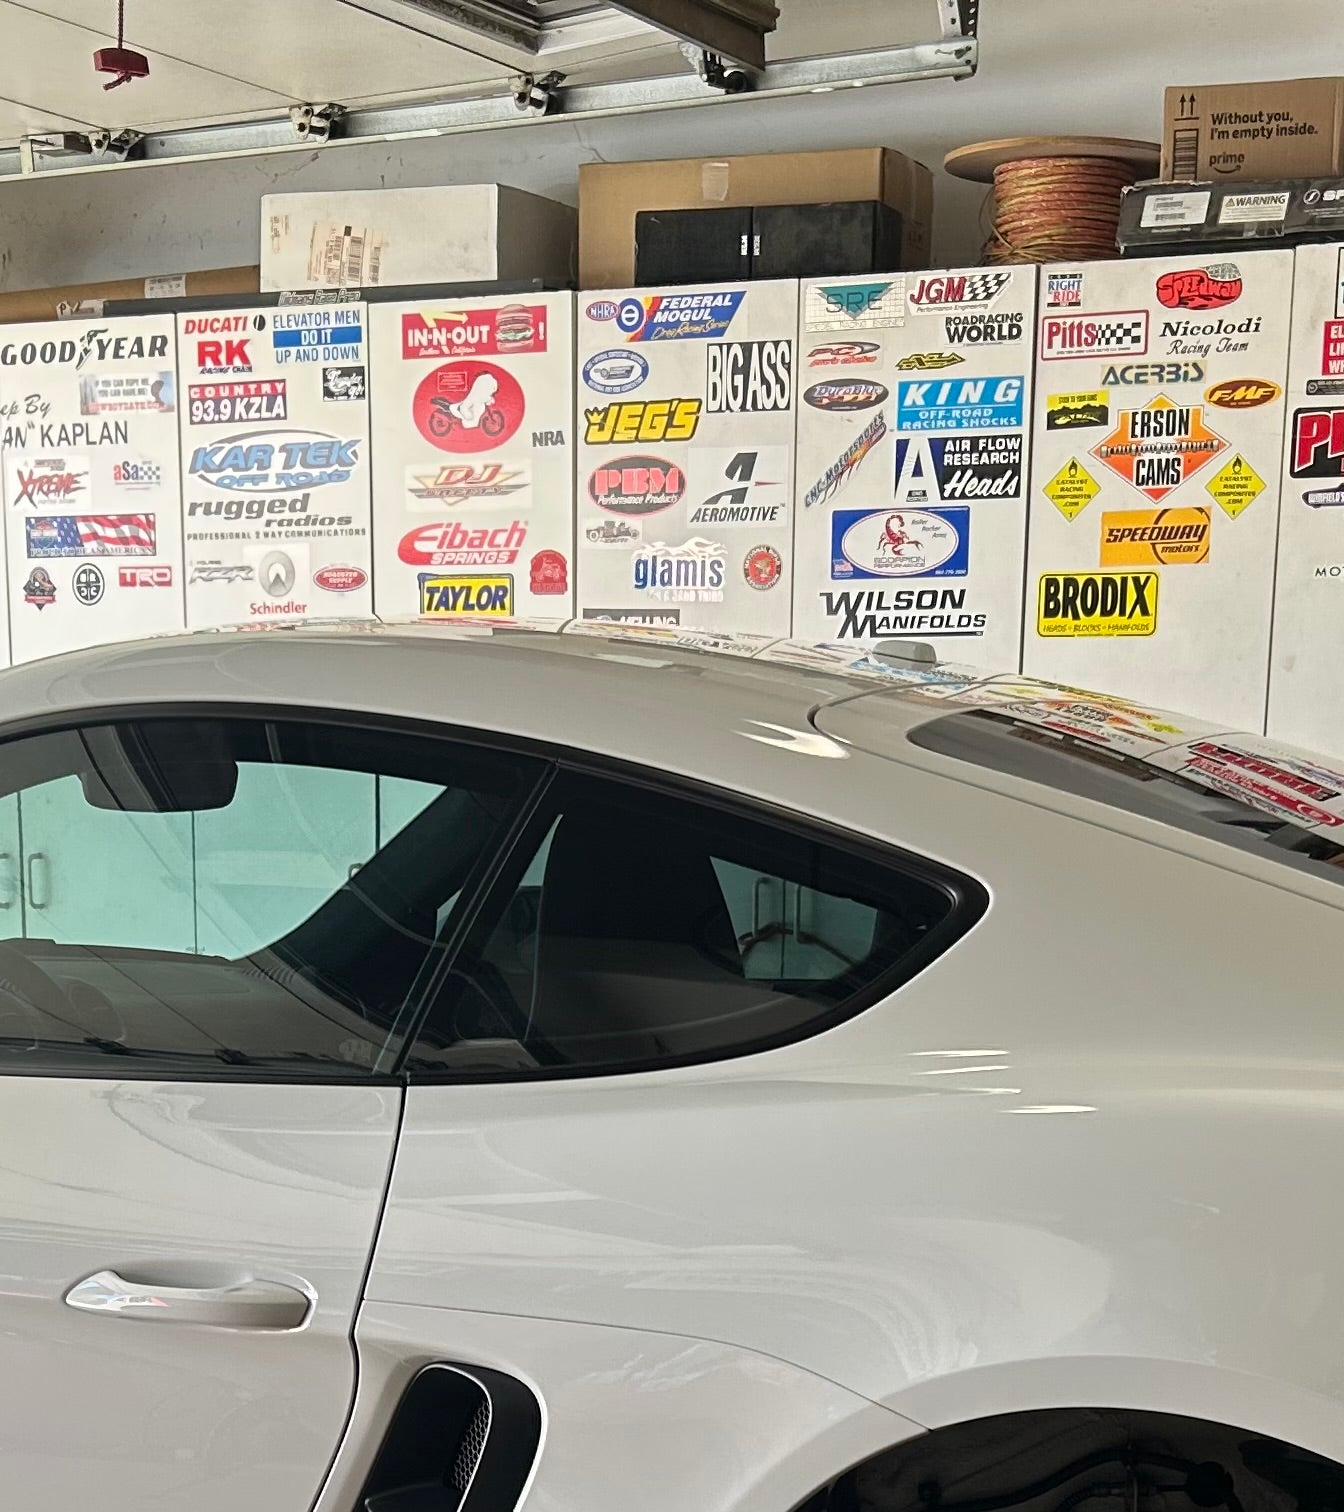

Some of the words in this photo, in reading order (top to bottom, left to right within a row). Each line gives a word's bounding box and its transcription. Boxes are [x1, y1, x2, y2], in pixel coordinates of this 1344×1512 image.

[1210, 112, 1263, 125] Without
[1265, 112, 1294, 124] you,
[1210, 127, 1229, 140] I'm
[1232, 125, 1274, 140] empty
[1276, 122, 1318, 136] inside.
[1209, 153, 1245, 167] prime
[1236, 195, 1286, 207] WARNING
[910, 276, 967, 304] JGM
[1048, 280, 1082, 291] RIGHT
[660, 294, 733, 309] FEDERAL
[1053, 290, 1081, 302] RIDE
[273, 313, 331, 329] ELEVATOR
[335, 310, 360, 324] MEN
[590, 304, 617, 318] NHRA
[654, 308, 712, 323] MOGUL
[945, 313, 1024, 326] ROADRACING
[184, 316, 248, 335] DUCATI
[946, 323, 1022, 343] WORLD
[1047, 321, 1096, 349] Pitts
[1159, 317, 1262, 337] Nicolodi
[301, 330, 318, 345] DO
[321, 329, 333, 344] IT
[197, 339, 251, 367] RK
[276, 349, 291, 364] UP
[295, 347, 319, 362] AND
[323, 345, 359, 360] DOWN
[1167, 340, 1211, 358] Racing
[1215, 337, 1249, 353] Team
[709, 342, 743, 412] BIG
[746, 341, 790, 411] ASS
[190, 382, 285, 398] COUNTRY
[904, 379, 1022, 406] KING
[1208, 386, 1276, 401] FMF
[24, 394, 50, 418] By
[191, 400, 232, 422] 93.9
[234, 396, 285, 420] KZLA
[919, 409, 993, 420] OFF-ROAD
[585, 399, 702, 444] JEG'S
[902, 420, 957, 430] RACING
[961, 417, 1018, 427] SHOCKS
[1130, 408, 1190, 439] ERSON
[40, 420, 128, 448] KAPLAN
[532, 430, 565, 447] NRA
[944, 440, 971, 451] AIR
[978, 438, 1020, 450] FLOW
[944, 452, 1020, 466] RESEARCH
[216, 474, 269, 488] OFF
[276, 469, 352, 486] ROAD
[434, 464, 503, 486] DJ
[595, 468, 679, 495] PBM
[1135, 458, 1181, 486] CAMS
[14, 468, 89, 509] XTREME
[944, 470, 1019, 498] Heads
[188, 493, 310, 520] rugged
[598, 494, 643, 505] Performance
[645, 494, 679, 504] Products
[265, 514, 352, 527] radios
[690, 506, 779, 523] AEROMOTIVE
[187, 532, 251, 540] PROFESSIONAL
[255, 531, 261, 539] 2
[263, 530, 282, 539] WAY
[284, 528, 366, 538] COMMUNICATIONS
[398, 520, 527, 566] Eibach
[1105, 524, 1208, 543] SPEEDWAY
[1160, 544, 1200, 553] motors
[431, 552, 509, 565] SPRINGS
[874, 555, 926, 563] SCORPION
[634, 555, 723, 589] glamis
[426, 585, 508, 611] TAYLOR
[819, 589, 967, 616] WILSON
[1043, 576, 1151, 621] BRODIX
[249, 601, 307, 615] Schindler
[837, 614, 987, 639] MANIFOLDS
[1073, 624, 1101, 632] BLOCKS
